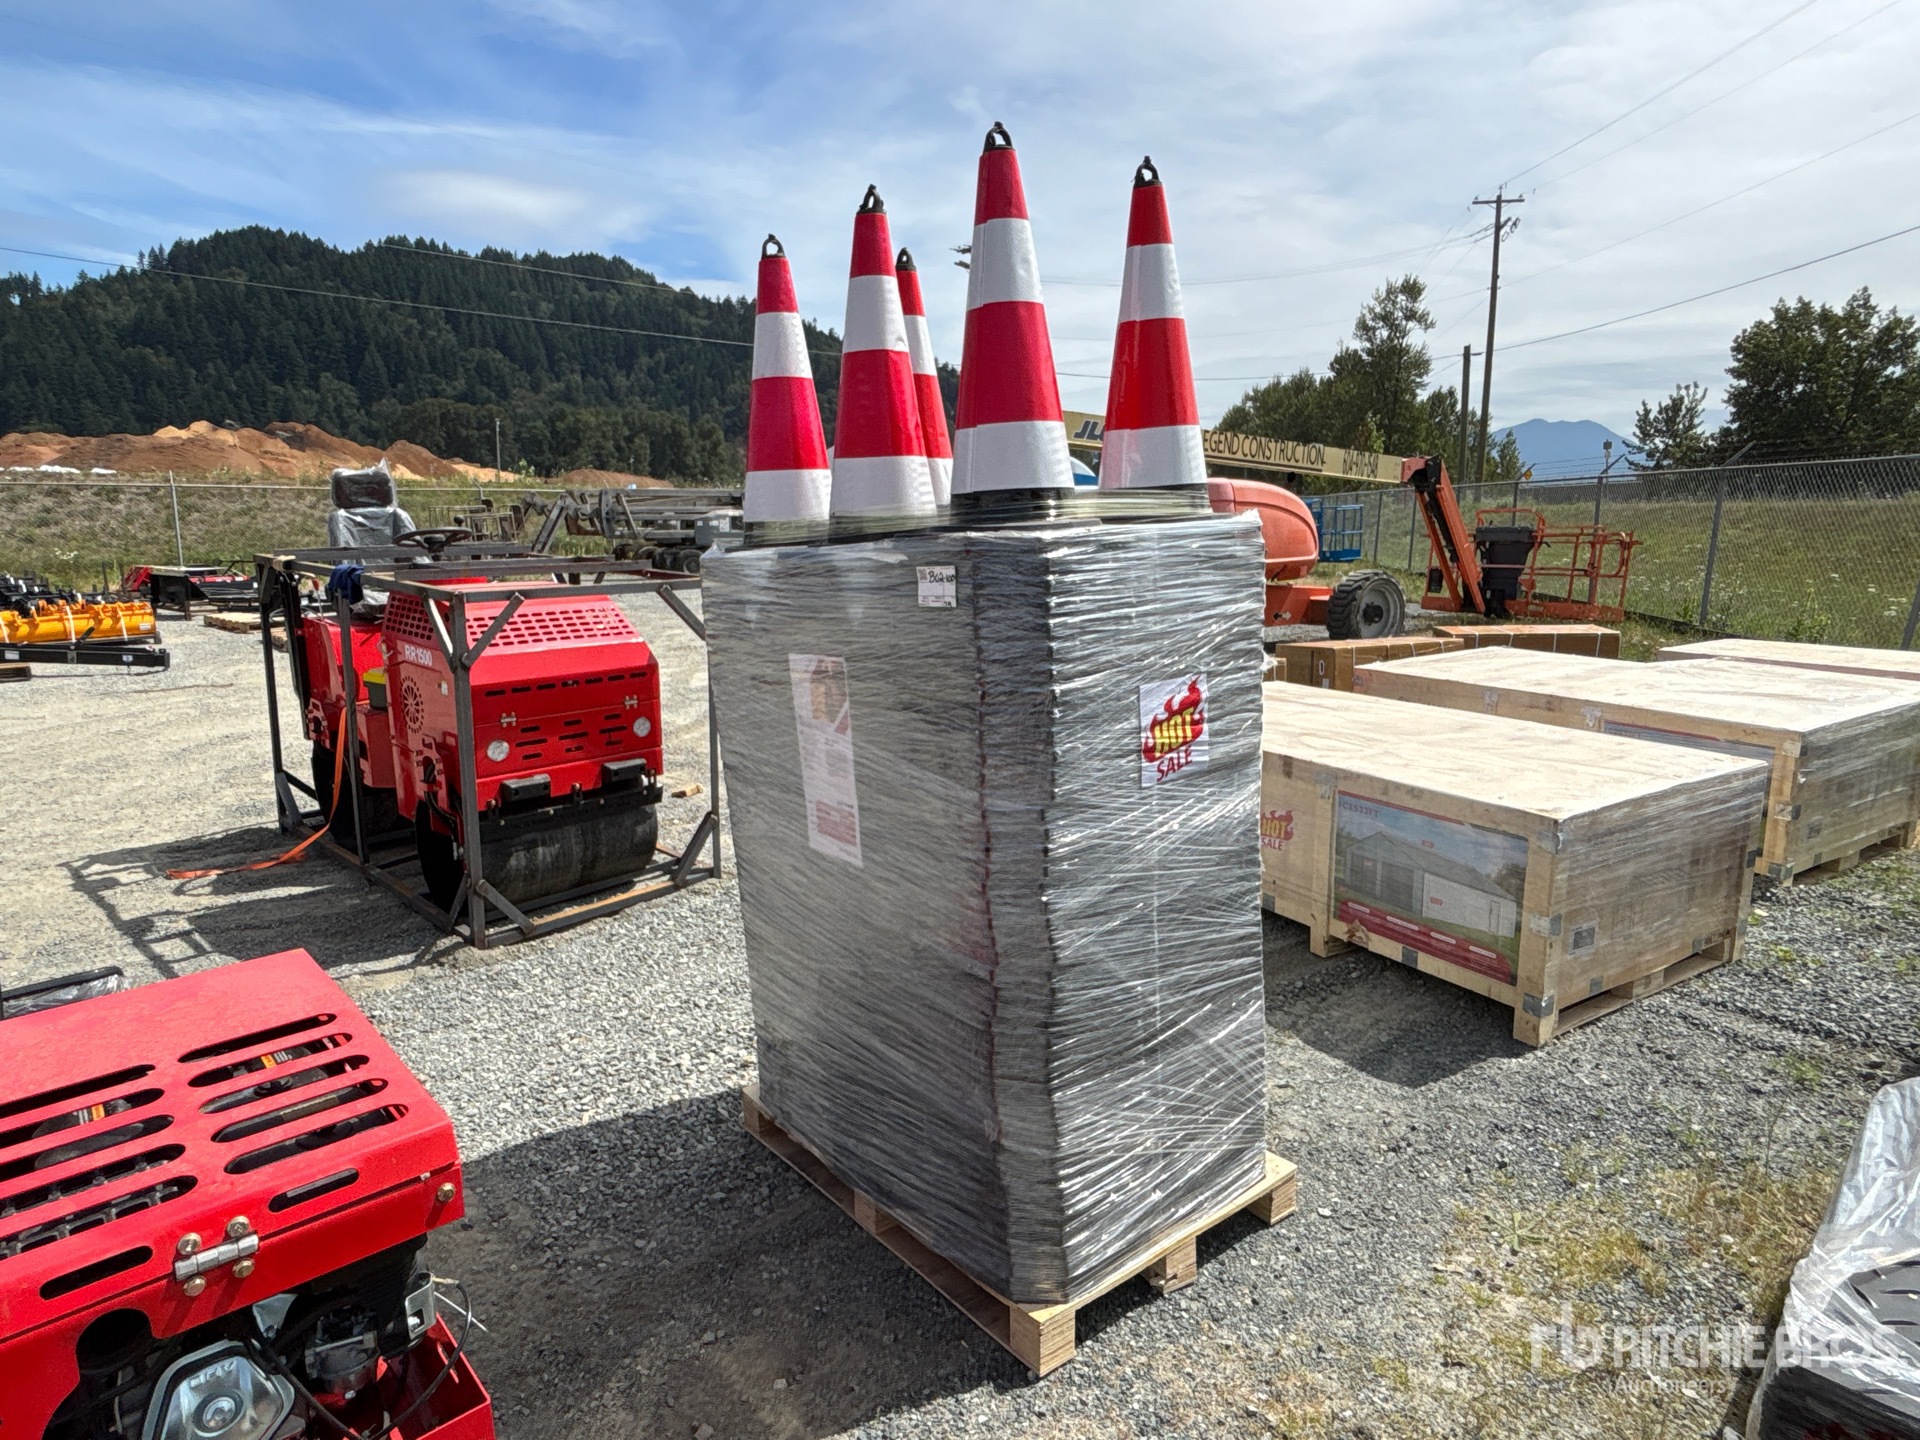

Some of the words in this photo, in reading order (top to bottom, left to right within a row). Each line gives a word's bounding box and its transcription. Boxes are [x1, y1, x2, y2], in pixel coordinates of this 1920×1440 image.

[1203, 430, 1240, 455] EGEND
[1154, 706, 1195, 758] HOT
[1156, 744, 1193, 782] SALE
[1261, 819, 1288, 839] HOT
[1261, 837, 1284, 850] SALE
